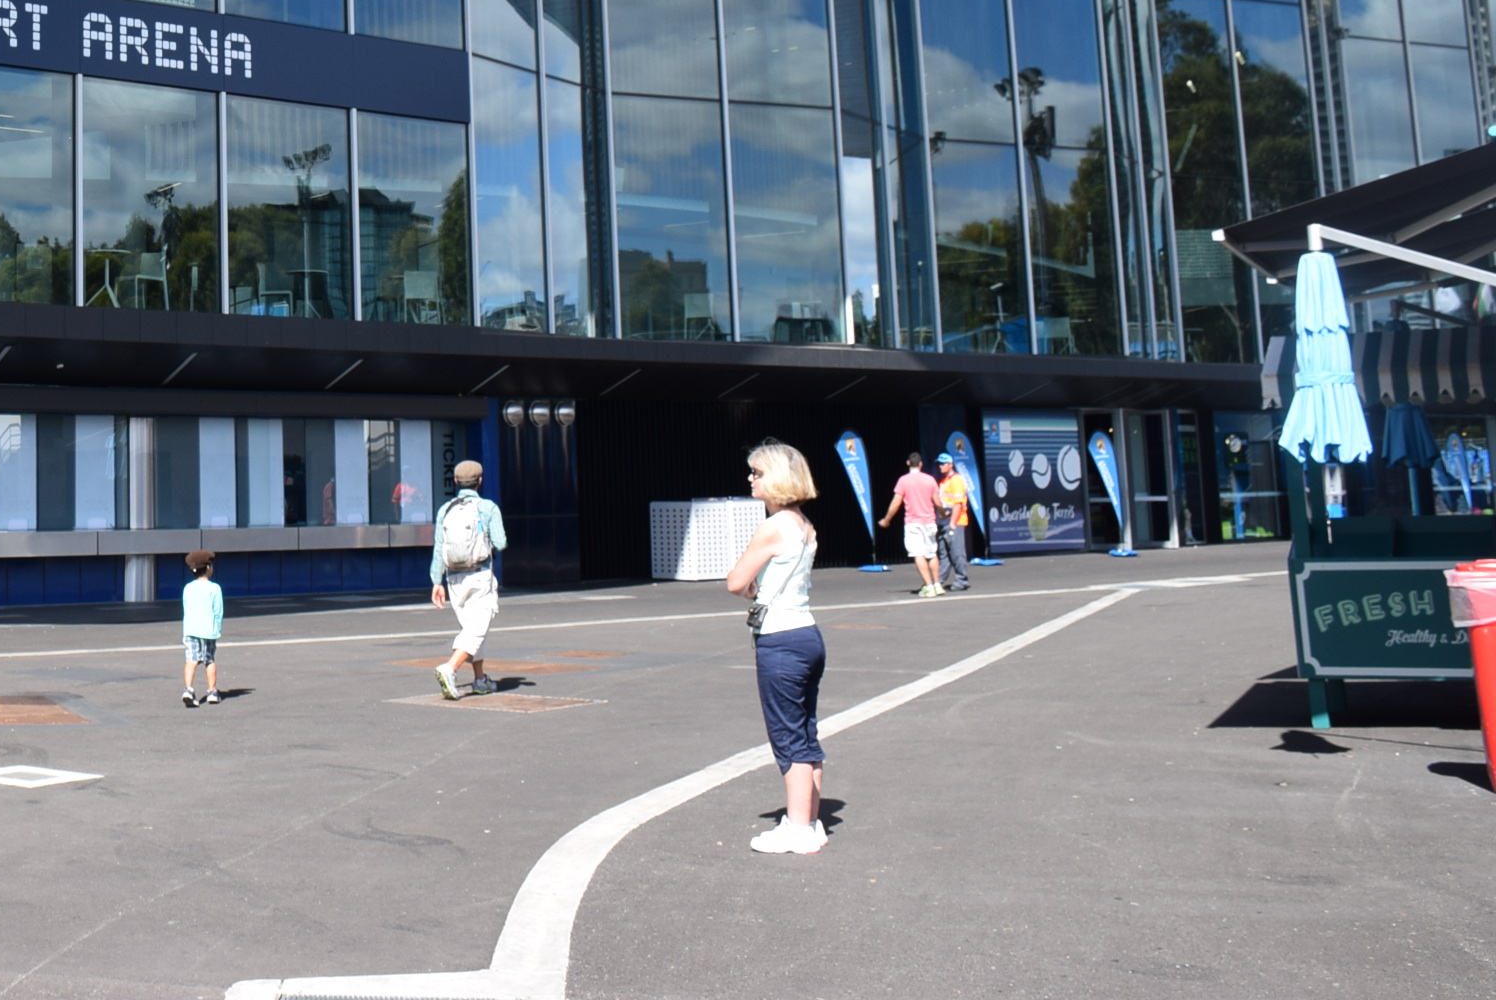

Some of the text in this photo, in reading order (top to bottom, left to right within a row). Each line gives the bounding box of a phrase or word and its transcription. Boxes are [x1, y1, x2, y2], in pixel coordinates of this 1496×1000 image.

[82, 12, 252, 78] ARENA
[443, 431, 456, 497] TICKET
[1313, 589, 1435, 633] FRESH
[1385, 629, 1438, 648] Healthy
[1440, 632, 1448, 644] &
